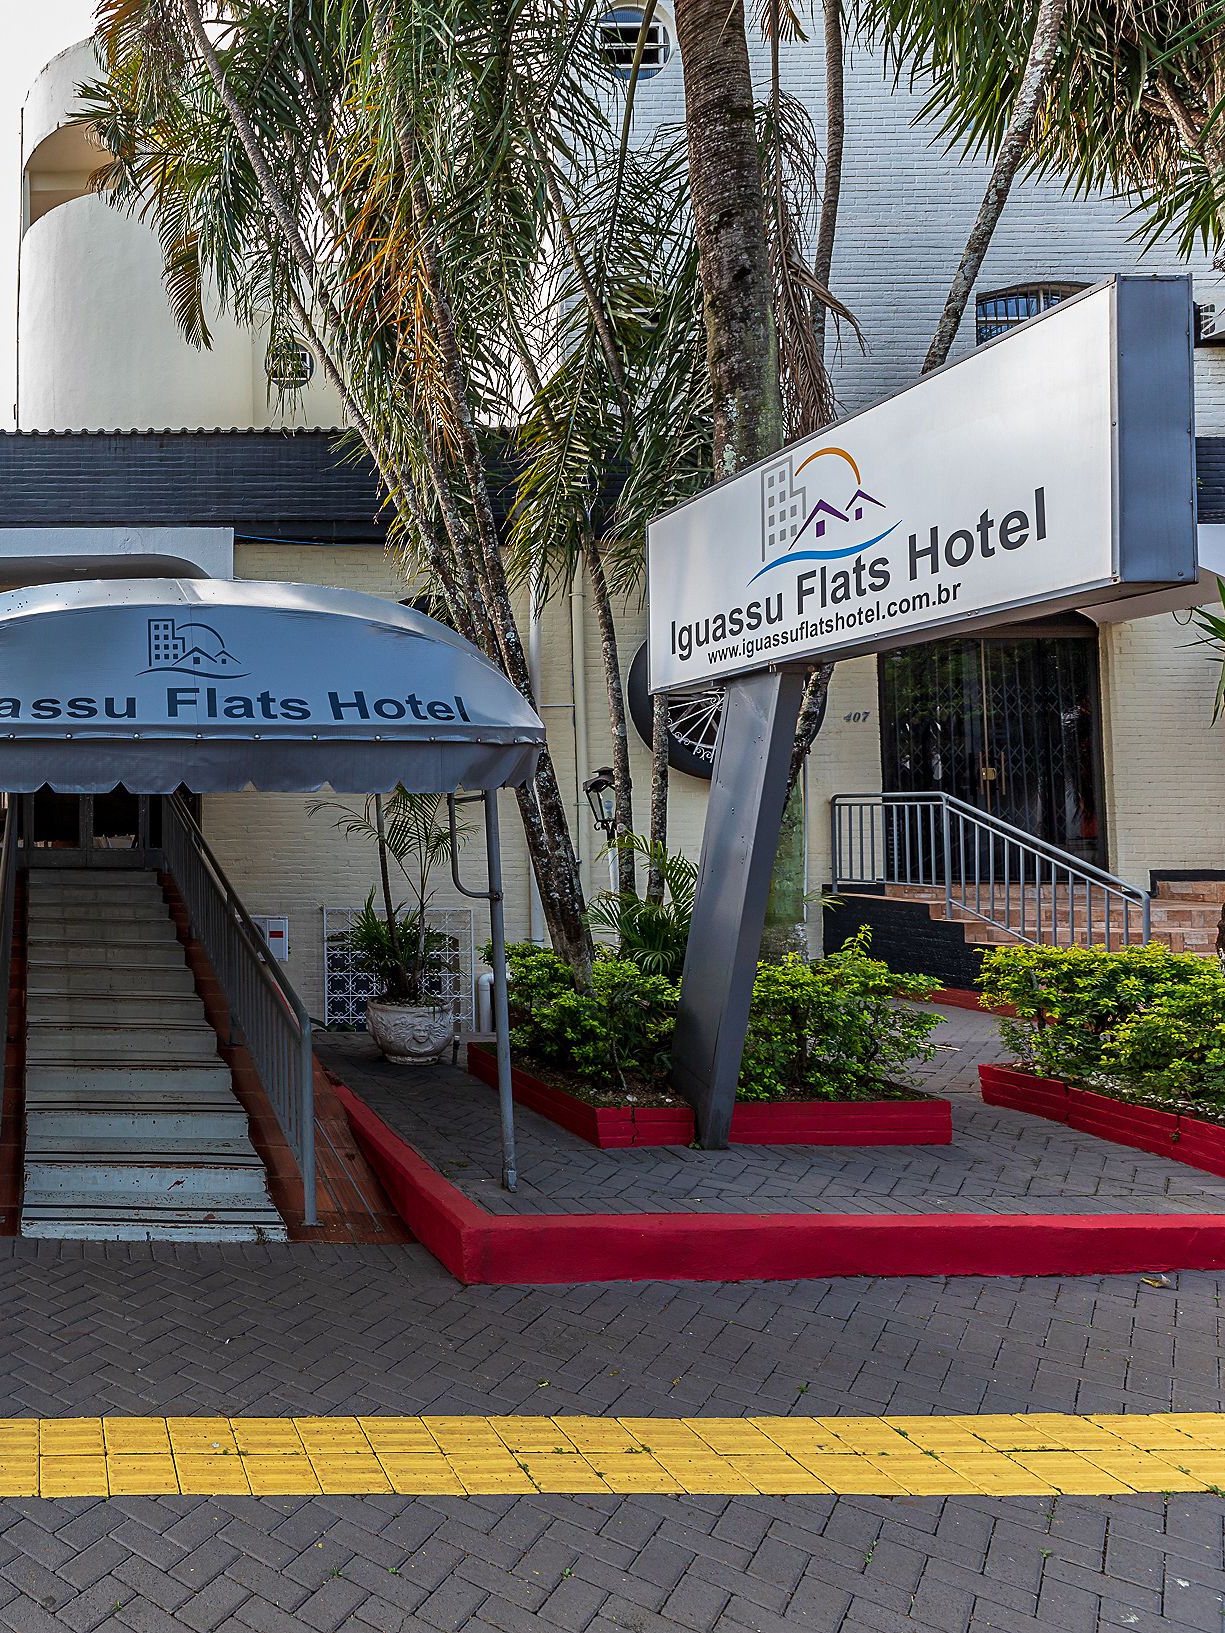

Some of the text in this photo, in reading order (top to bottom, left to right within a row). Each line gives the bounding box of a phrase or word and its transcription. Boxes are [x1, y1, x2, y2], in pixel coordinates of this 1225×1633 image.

[671, 486, 1047, 662] Iguassu Flats Hotel
[707, 582, 961, 664] www.iguassuflatshotel.com.br
[168, 687, 311, 721] Flats
[328, 689, 472, 722] Hotel
[843, 711, 870, 722] 407
